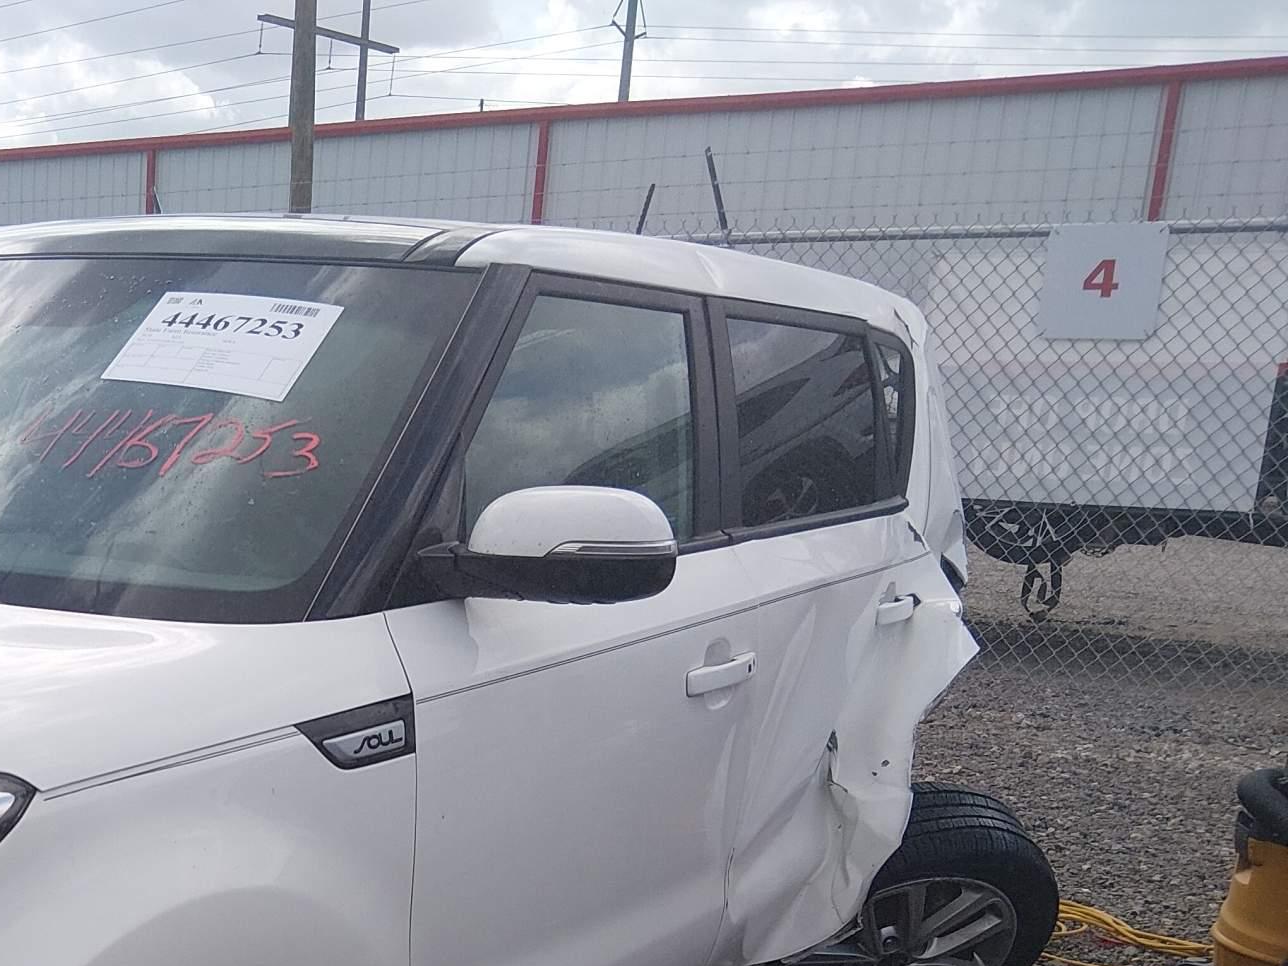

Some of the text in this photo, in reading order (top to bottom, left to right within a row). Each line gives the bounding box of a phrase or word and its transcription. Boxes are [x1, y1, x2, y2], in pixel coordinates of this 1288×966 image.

[1081, 258, 1120, 299] 4
[161, 311, 305, 340] 44467253
[353, 729, 403, 754] SOUL
